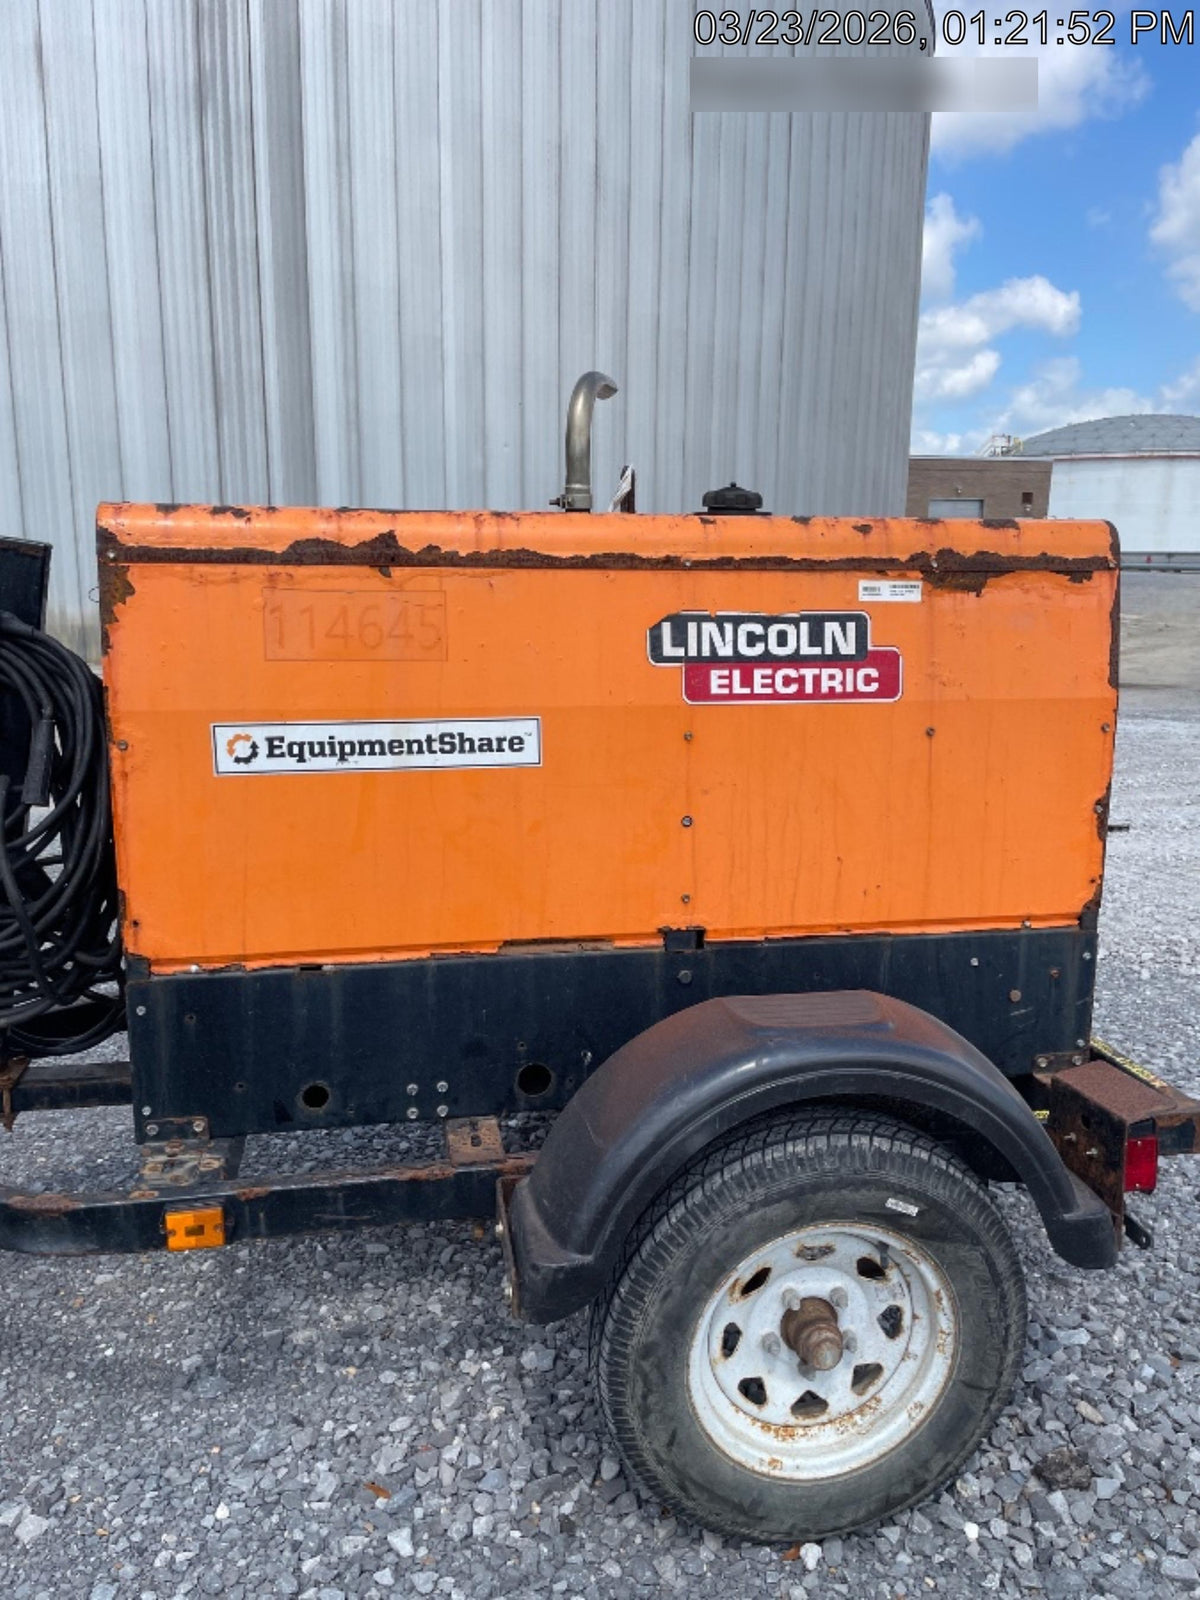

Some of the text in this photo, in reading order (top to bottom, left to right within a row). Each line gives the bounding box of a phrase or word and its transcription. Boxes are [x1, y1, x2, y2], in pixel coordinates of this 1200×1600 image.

[269, 603, 442, 651] 114645
[661, 622, 856, 657] LINCOLN
[710, 668, 880, 695] ELECTRIC
[265, 731, 525, 763] EquipmentShare
